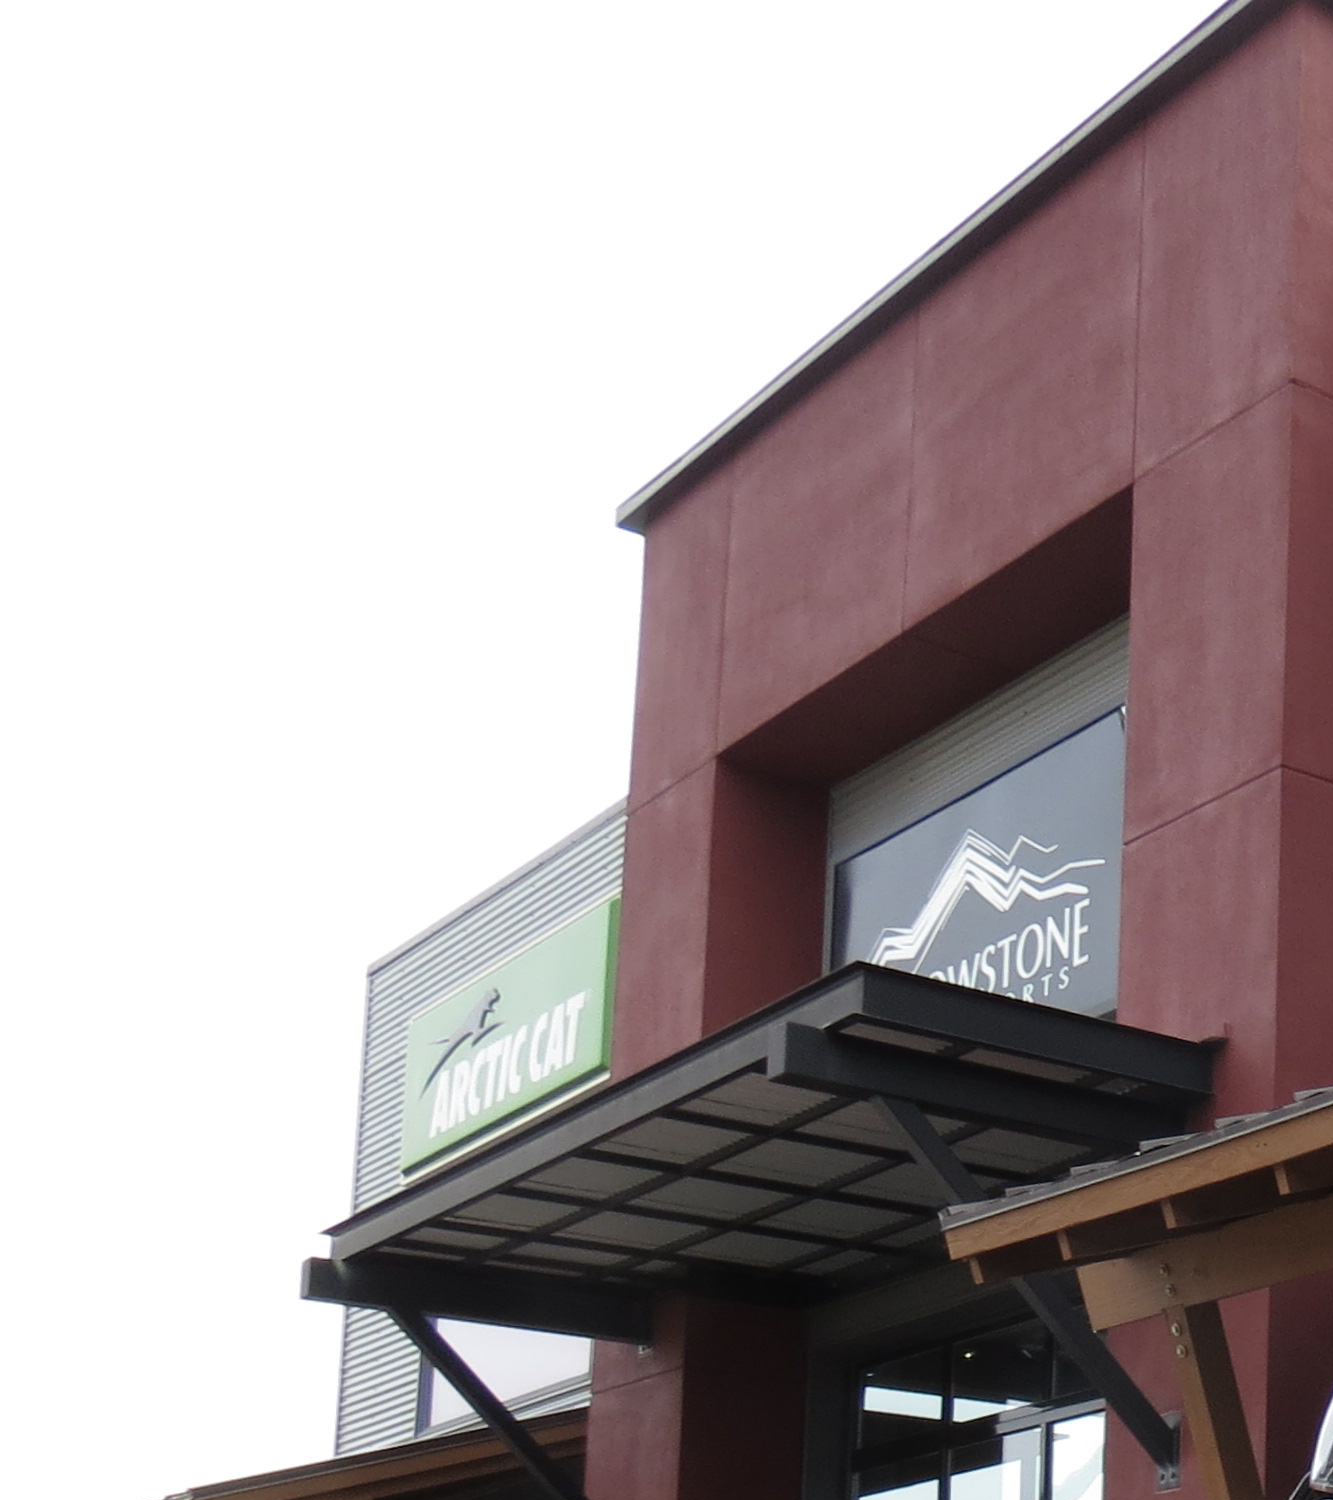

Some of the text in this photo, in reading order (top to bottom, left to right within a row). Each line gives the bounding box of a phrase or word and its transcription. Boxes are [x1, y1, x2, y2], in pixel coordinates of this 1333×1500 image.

[1004, 966, 1070, 1003] RTS
[428, 991, 586, 1139] ARCTIC CAT
